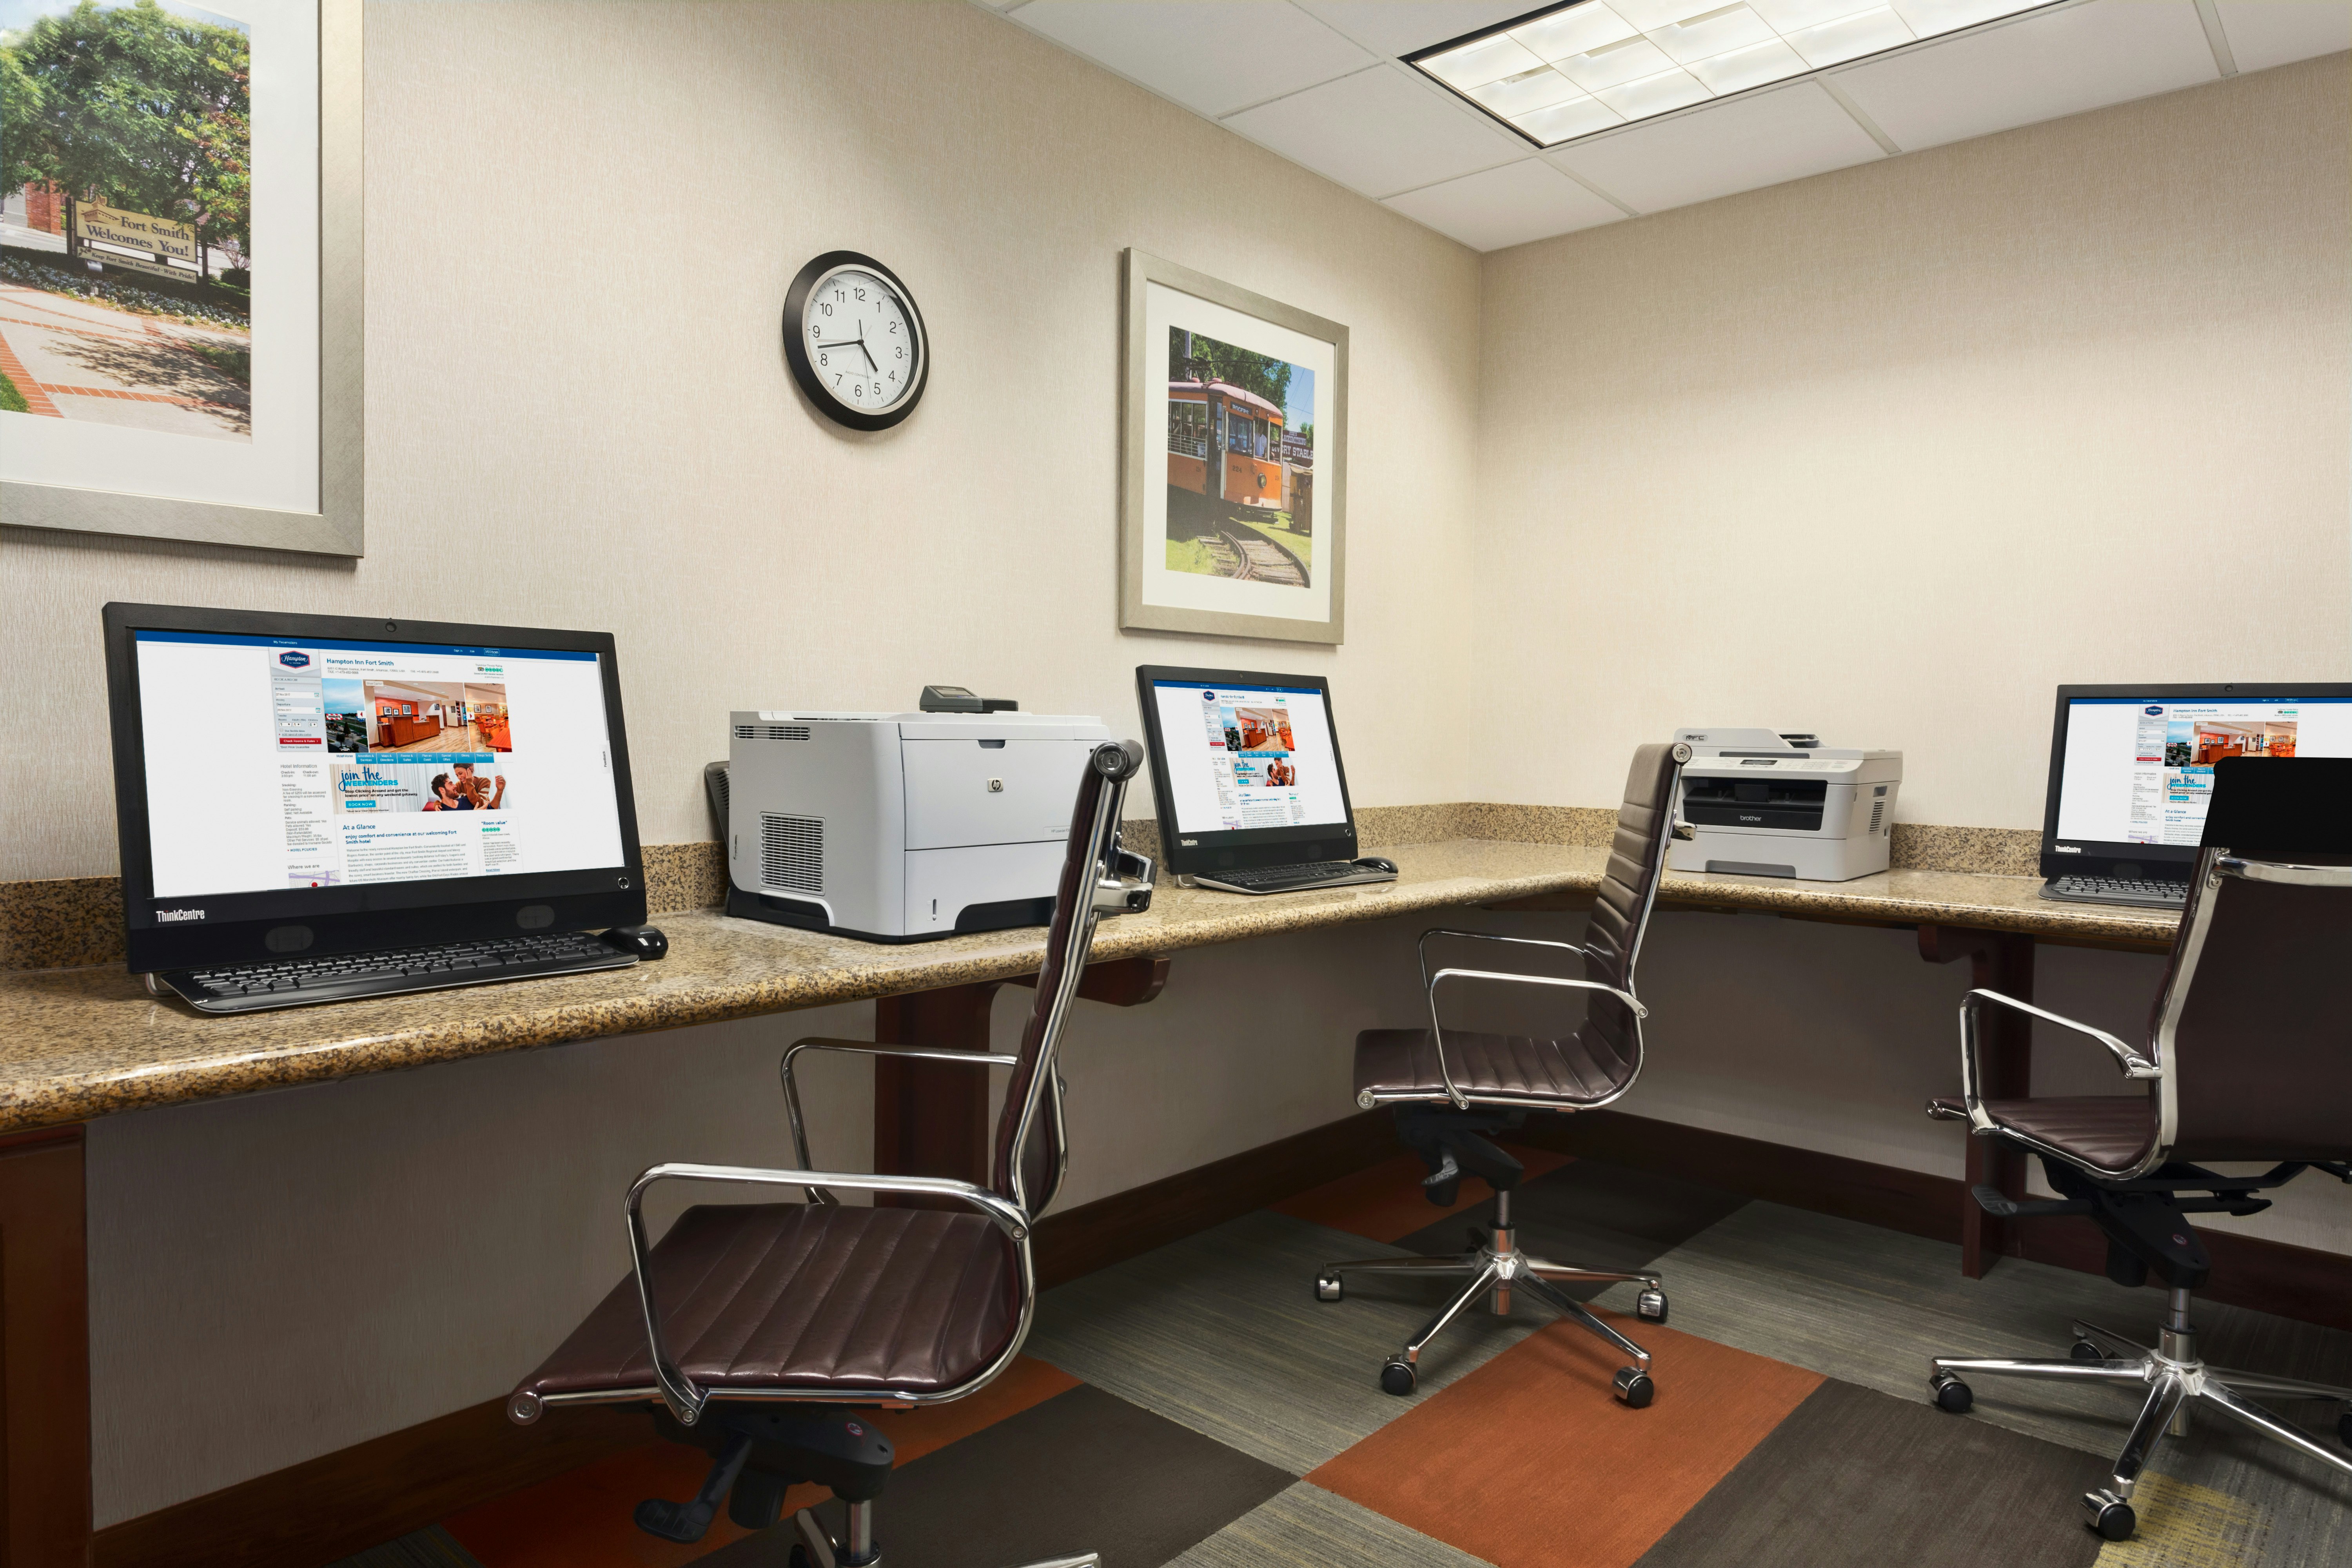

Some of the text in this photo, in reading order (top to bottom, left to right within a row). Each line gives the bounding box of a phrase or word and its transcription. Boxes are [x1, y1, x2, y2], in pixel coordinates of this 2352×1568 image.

[121, 216, 190, 241] Fort Smith
[86, 224, 189, 256] Welcomes You!
[835, 289, 845, 303] 11
[853, 287, 866, 301] 12
[820, 302, 833, 316] 10
[876, 301, 880, 313] 1
[813, 325, 820, 338] 9
[889, 321, 897, 334] 2
[895, 347, 902, 359] 3
[820, 354, 828, 366] 8
[835, 373, 842, 386] 7
[889, 370, 895, 382] 4
[855, 385, 862, 397] 6
[874, 383, 881, 395] 5
[1232, 404, 1249, 415] ROGERS
[339, 766, 383, 792] join the
[993, 780, 1000, 791] hp
[2167, 775, 2196, 790] join the
[156, 909, 205, 922] ThinkCentre
